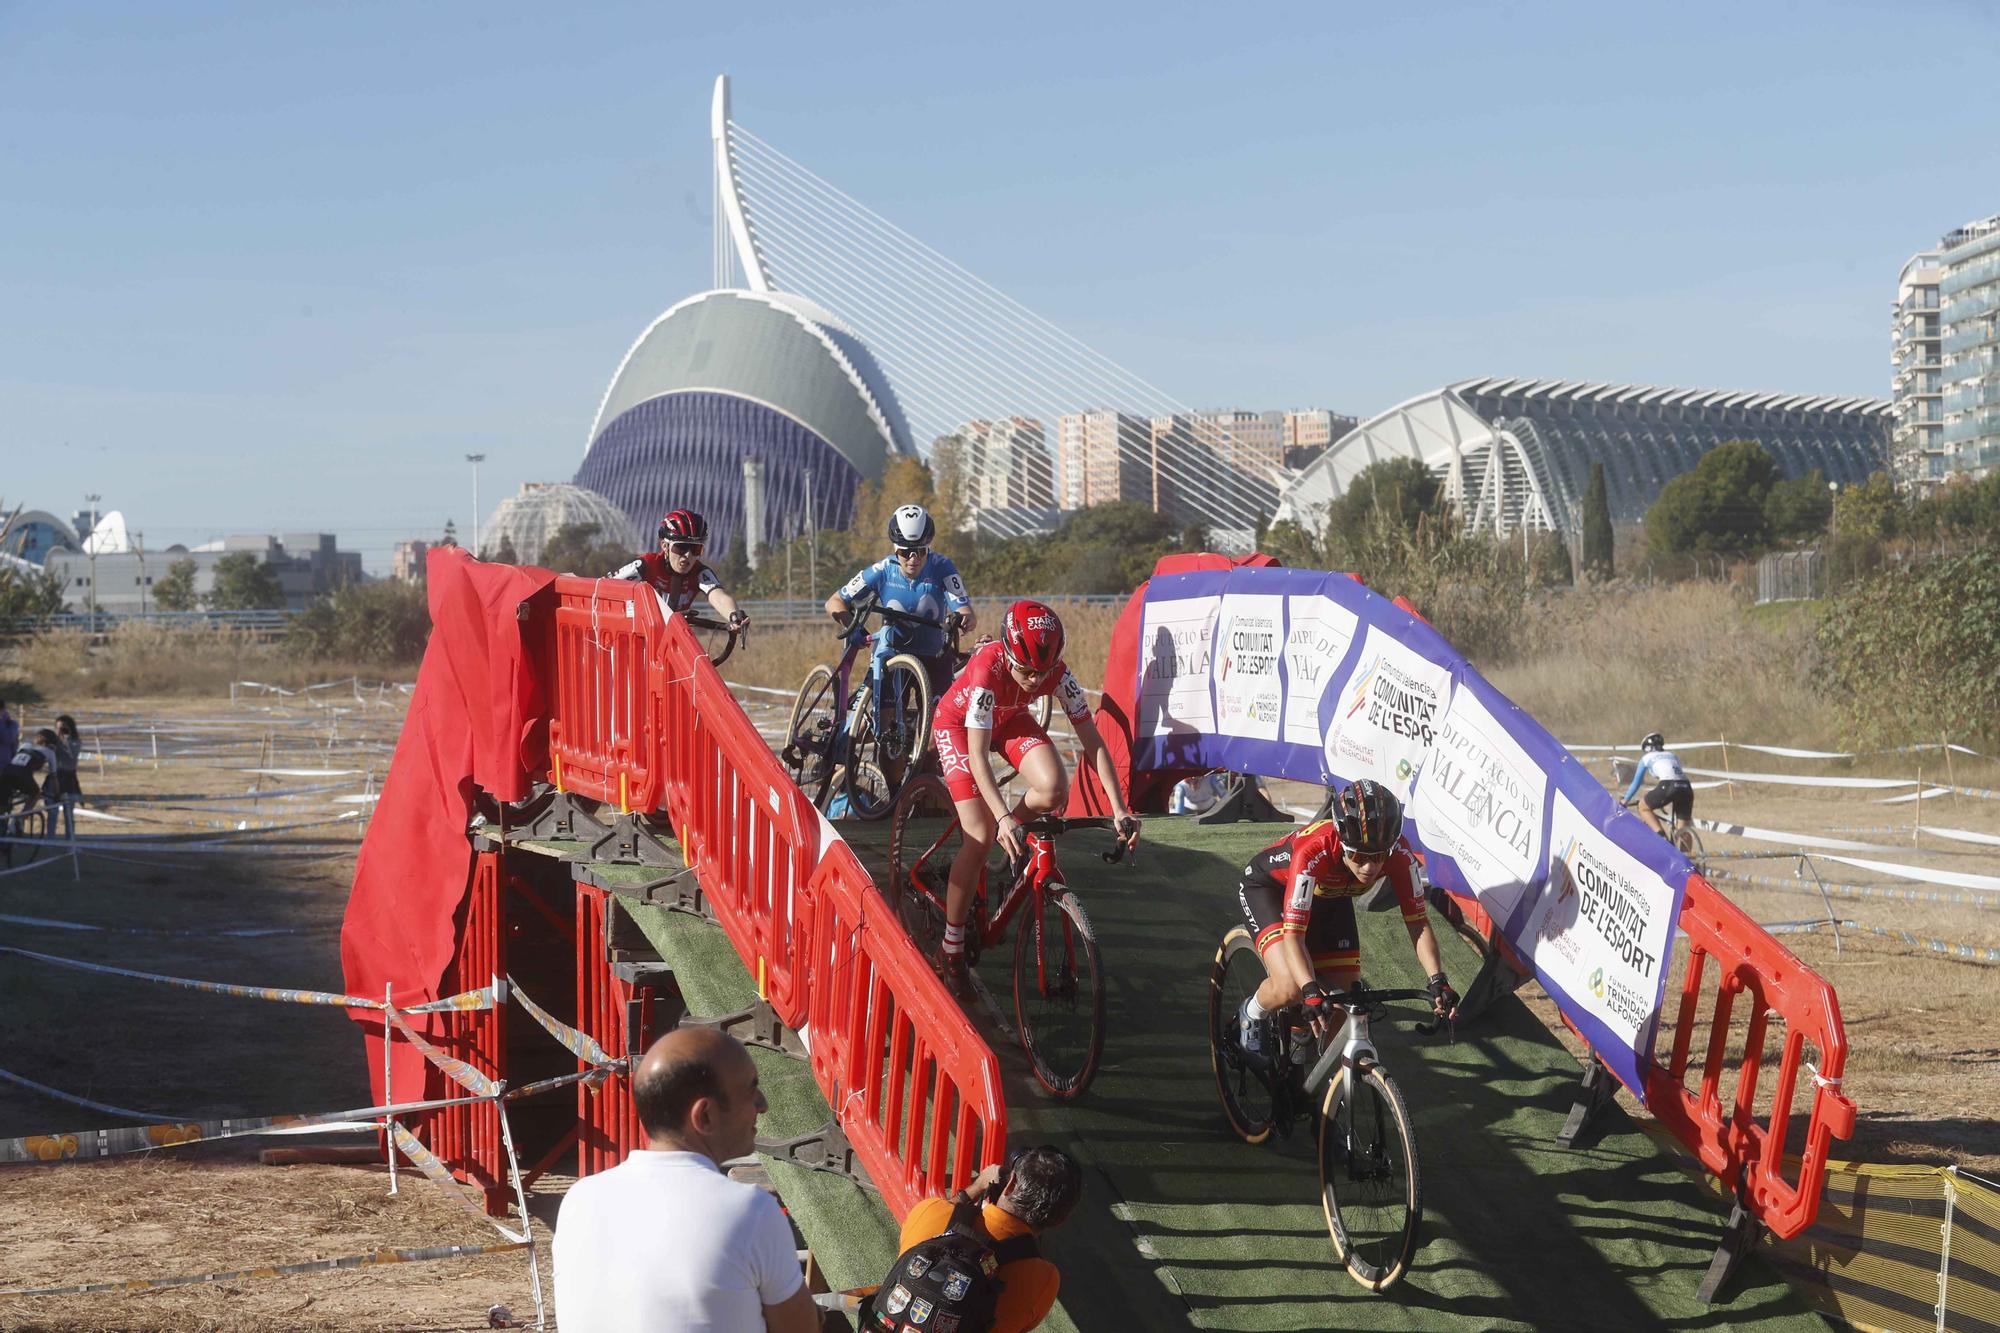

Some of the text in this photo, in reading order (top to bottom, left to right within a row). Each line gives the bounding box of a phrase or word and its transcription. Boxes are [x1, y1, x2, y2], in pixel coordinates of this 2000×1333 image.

[952, 577, 960, 590] 8
[1027, 616, 1052, 625] STAR
[976, 692, 993, 712] 49
[1065, 680, 1081, 699] 49
[1373, 674, 1437, 722] COMUNITAT
[1368, 700, 1383, 726] DE
[1522, 793, 1537, 820] DE
[1301, 879, 1309, 898] 1
[1578, 842, 1651, 917] Comunitat Valenciana
[1239, 881, 1261, 933] NESTA
[1577, 862, 1648, 943] COMUNITAT
[1580, 890, 1656, 978] DE L'ESPORT
[1606, 998, 1643, 1033] ALFONSO
[1607, 984, 1646, 1021] TRINIDAD
